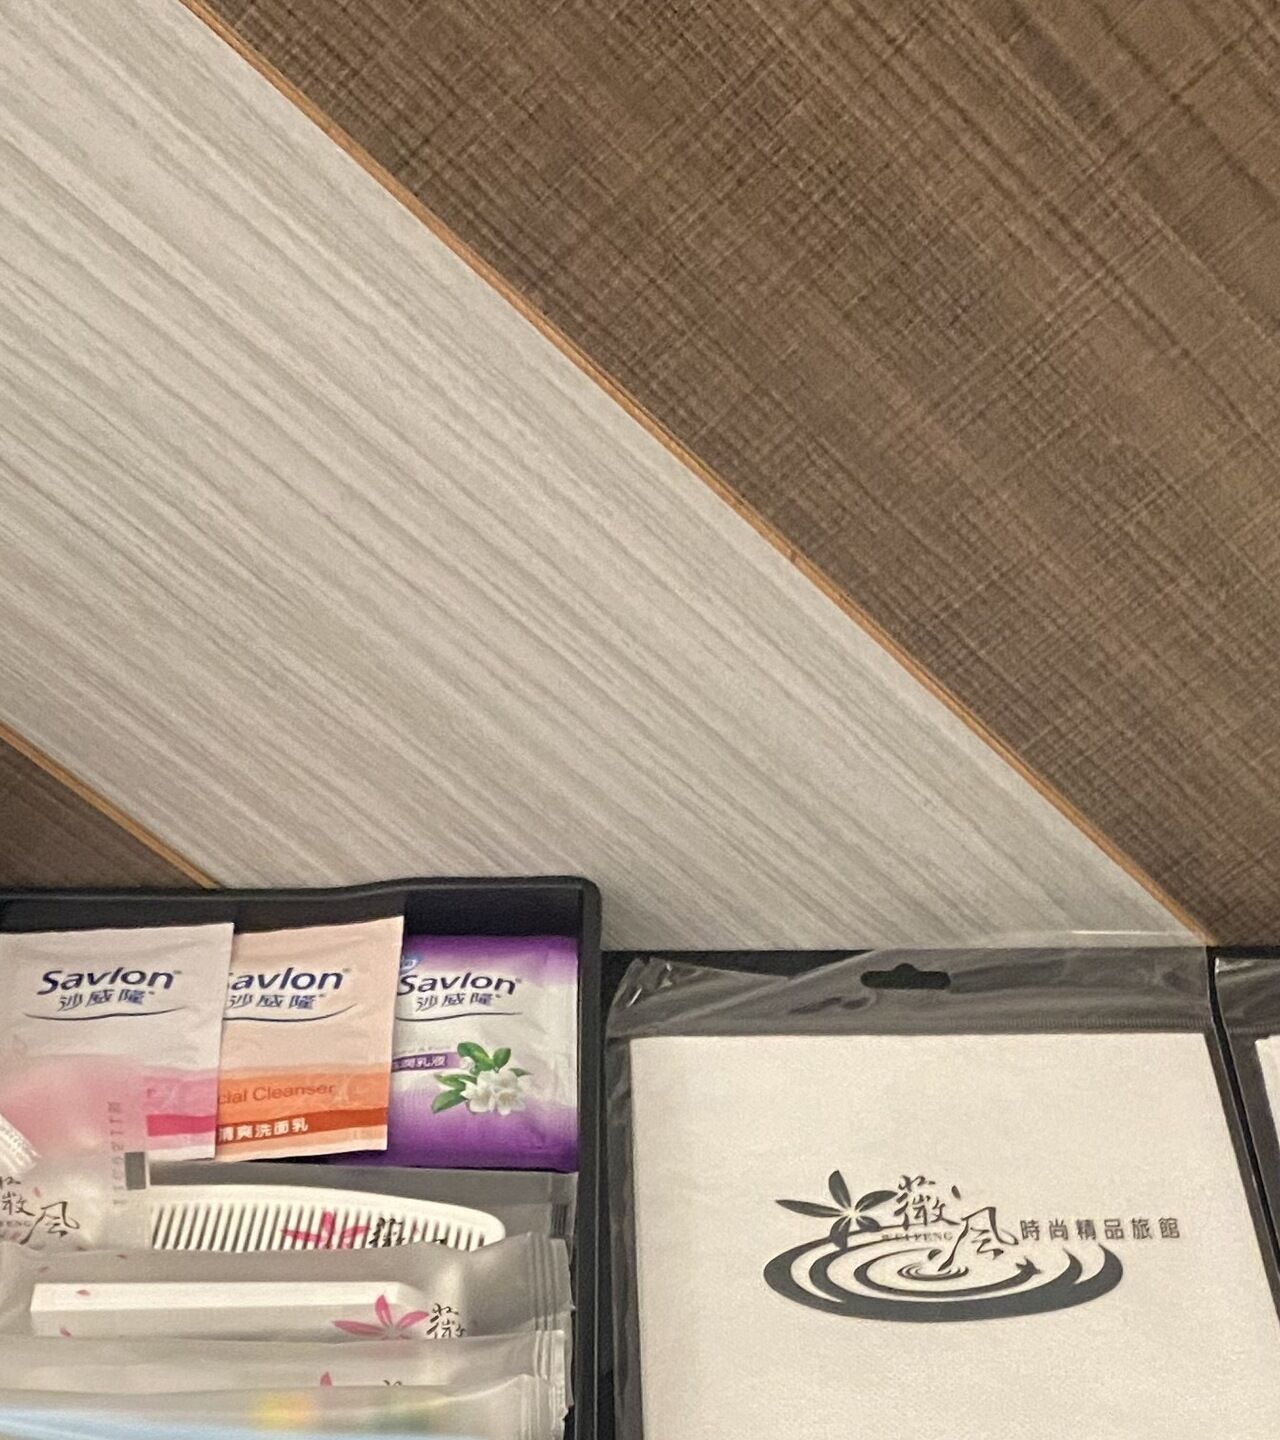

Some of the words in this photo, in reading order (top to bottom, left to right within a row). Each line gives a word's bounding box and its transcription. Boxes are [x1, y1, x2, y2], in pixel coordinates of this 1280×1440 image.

[37, 967, 173, 996] Savlon
[228, 968, 343, 993] avlon
[397, 972, 517, 996] Savlon
[57, 988, 145, 1012] 沙威隆
[415, 993, 493, 1012] 沙威隆
[218, 1090, 247, 1106] cial
[252, 1084, 335, 1102] Cleanser
